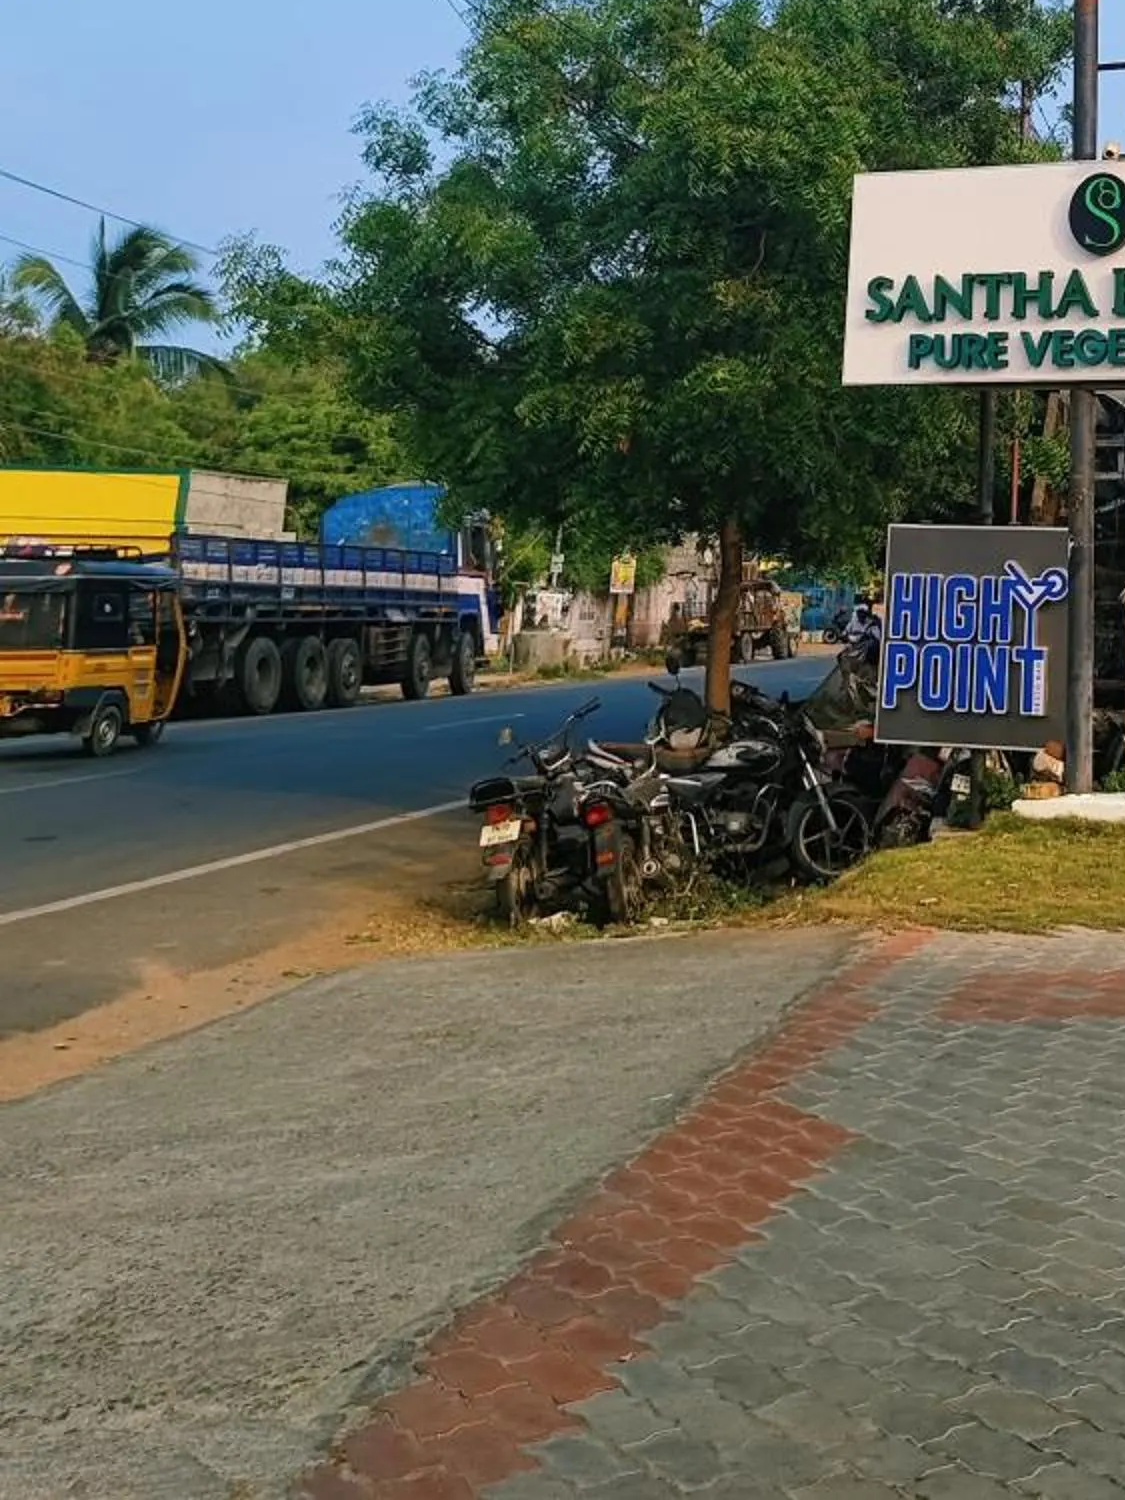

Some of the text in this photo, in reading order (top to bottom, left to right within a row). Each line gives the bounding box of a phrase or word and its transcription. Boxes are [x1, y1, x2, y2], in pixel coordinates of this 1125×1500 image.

[865, 268, 1100, 324] SANTHA
[908, 331, 1009, 370] PURE
[889, 573, 1012, 643] HIGH
[881, 642, 1048, 717] POINT
